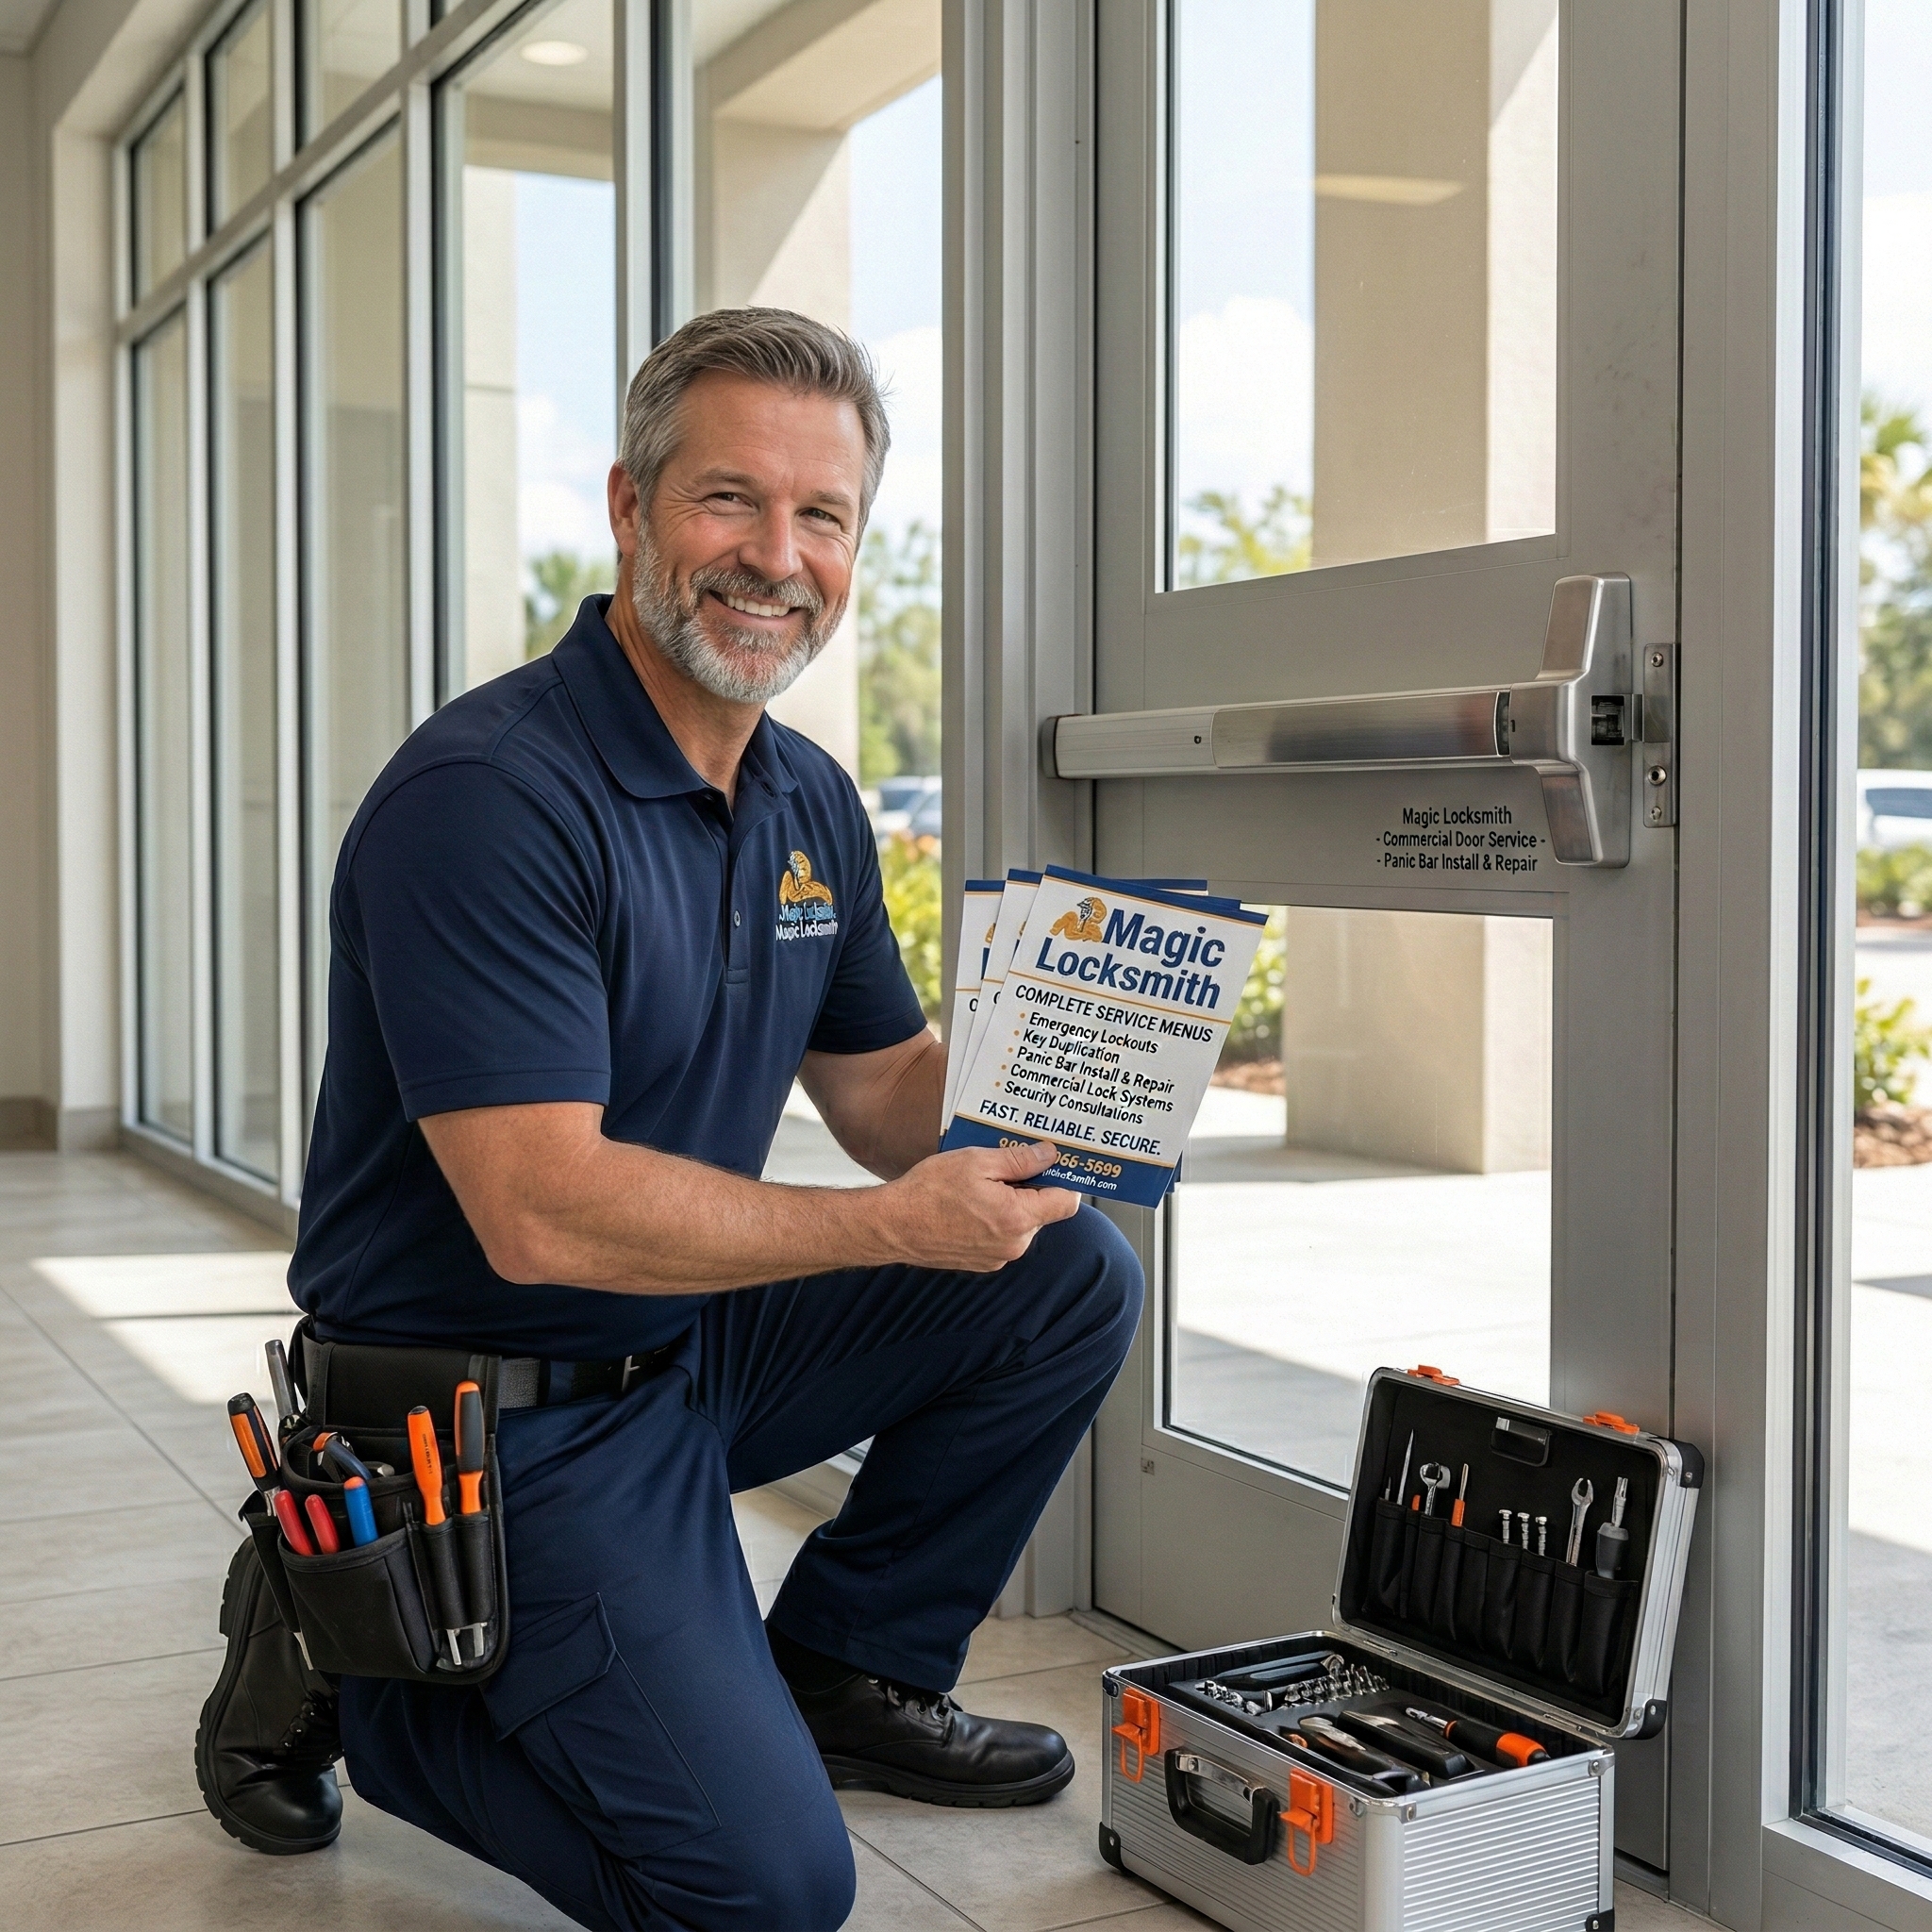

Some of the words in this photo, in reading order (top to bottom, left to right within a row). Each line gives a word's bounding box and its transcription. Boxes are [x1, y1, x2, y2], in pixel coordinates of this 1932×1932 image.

[1383, 830, 1452, 846] Commercial
[1456, 831, 1485, 846] Door
[1489, 831, 1537, 847] Service
[1403, 808, 1440, 828] Magic
[1443, 806, 1511, 824] Locksmith
[1384, 853, 1415, 868] Panic
[1419, 854, 1439, 869] Bar
[1442, 854, 1478, 870] Install
[1482, 854, 1492, 871] &
[1496, 855, 1538, 874] Repair
[1104, 908, 1225, 968] Magic
[1036, 937, 1220, 1009] Locksmith
[1015, 985, 1092, 1017] COMPLETE
[1096, 1005, 1157, 1032] SERVICE
[1159, 1020, 1213, 1042] MENUS
[1030, 1012, 1098, 1042] Emergency
[1101, 1030, 1158, 1053] Lockouts
[1024, 1029, 1046, 1048] Key
[1049, 1037, 1120, 1064] Duplication
[1010, 1064, 1085, 1093] Commercial
[1088, 1082, 1118, 1100] Lock
[1121, 1091, 1174, 1112] Systems
[1017, 1046, 1052, 1066] Panic
[1055, 1057, 1077, 1073] Bar
[1080, 1062, 1120, 1082] Install
[1122, 1073, 1130, 1084] &
[1134, 1074, 1174, 1094] Repair
[1005, 1081, 1056, 1108] Security
[1058, 1094, 1143, 1124] Consultations
[980, 1100, 1019, 1124] FAST.
[1024, 1112, 1096, 1141] RELIABLE.
[1101, 1130, 1161, 1155] SECURE.
